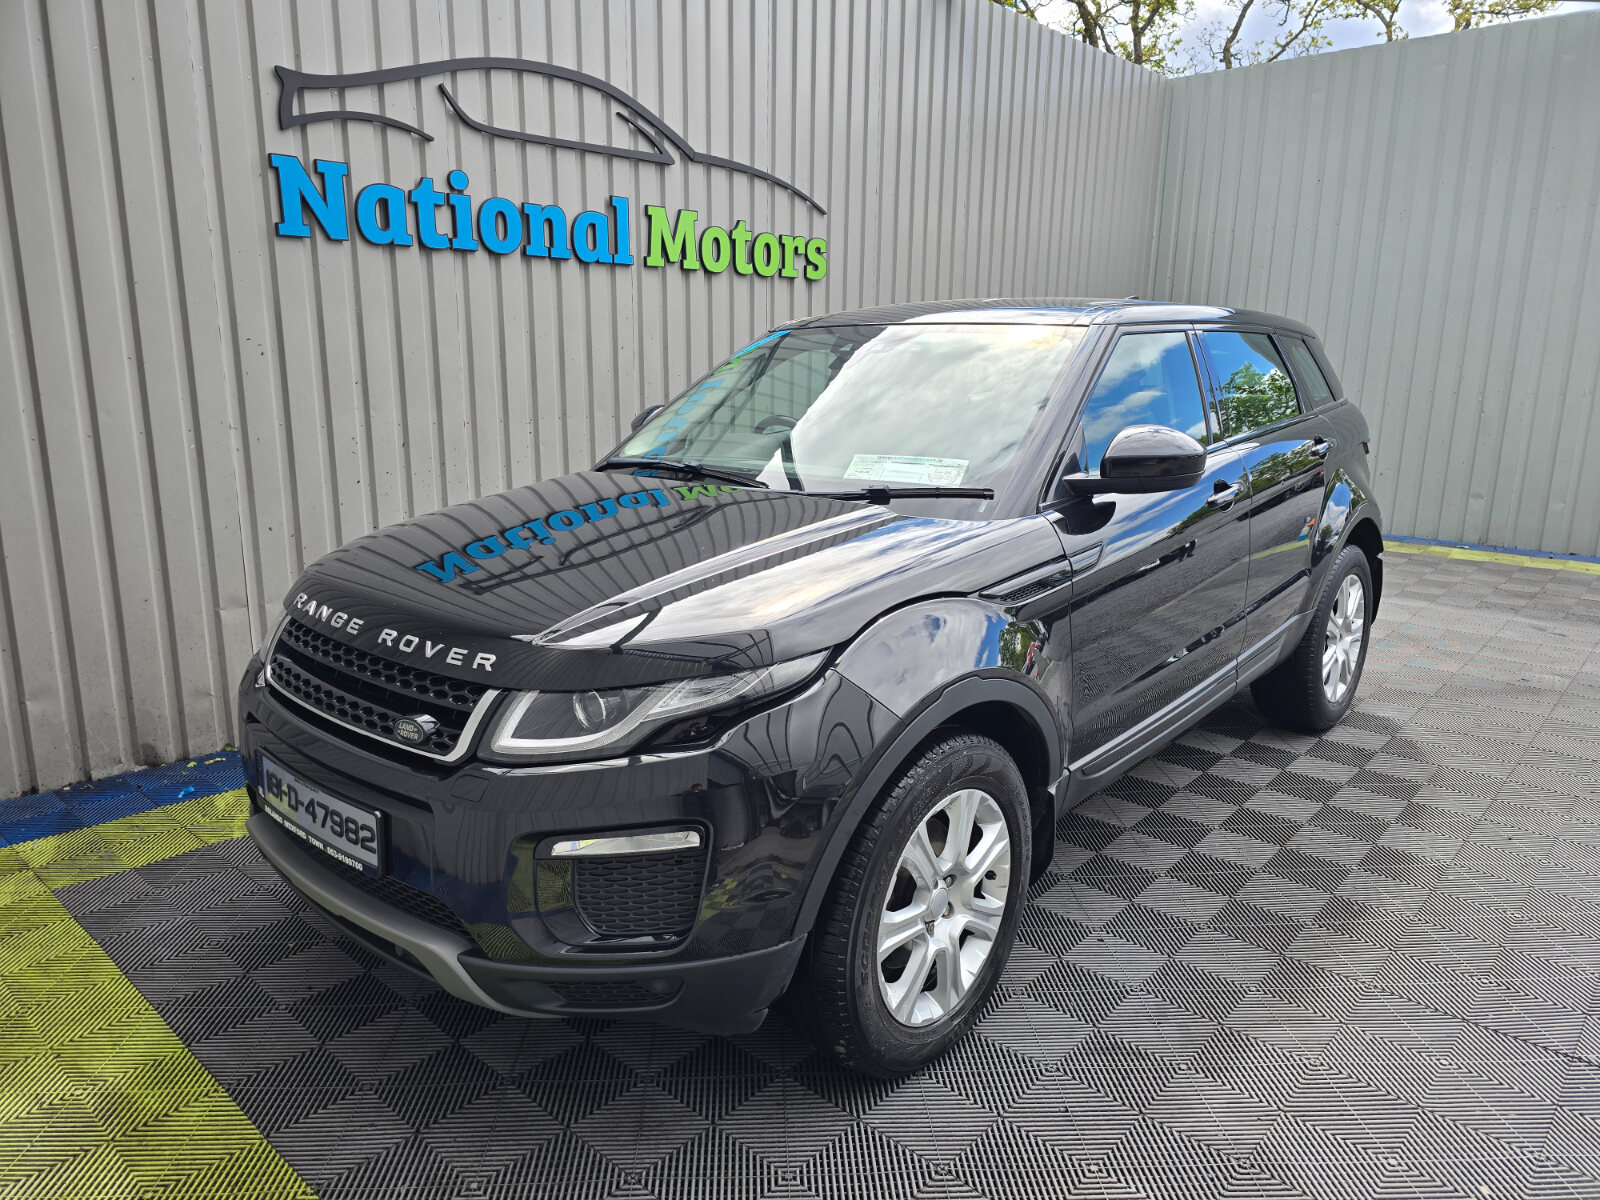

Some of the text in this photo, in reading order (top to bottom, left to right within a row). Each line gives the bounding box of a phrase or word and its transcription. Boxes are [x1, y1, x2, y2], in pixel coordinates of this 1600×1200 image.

[269, 152, 827, 281] National Motors
[293, 592, 497, 672] RANGE ROVER
[399, 722, 414, 732] LAND
[400, 730, 418, 740] ROVER
[284, 819, 307, 840] WEXFORD
[308, 835, 324, 850] TOWN
